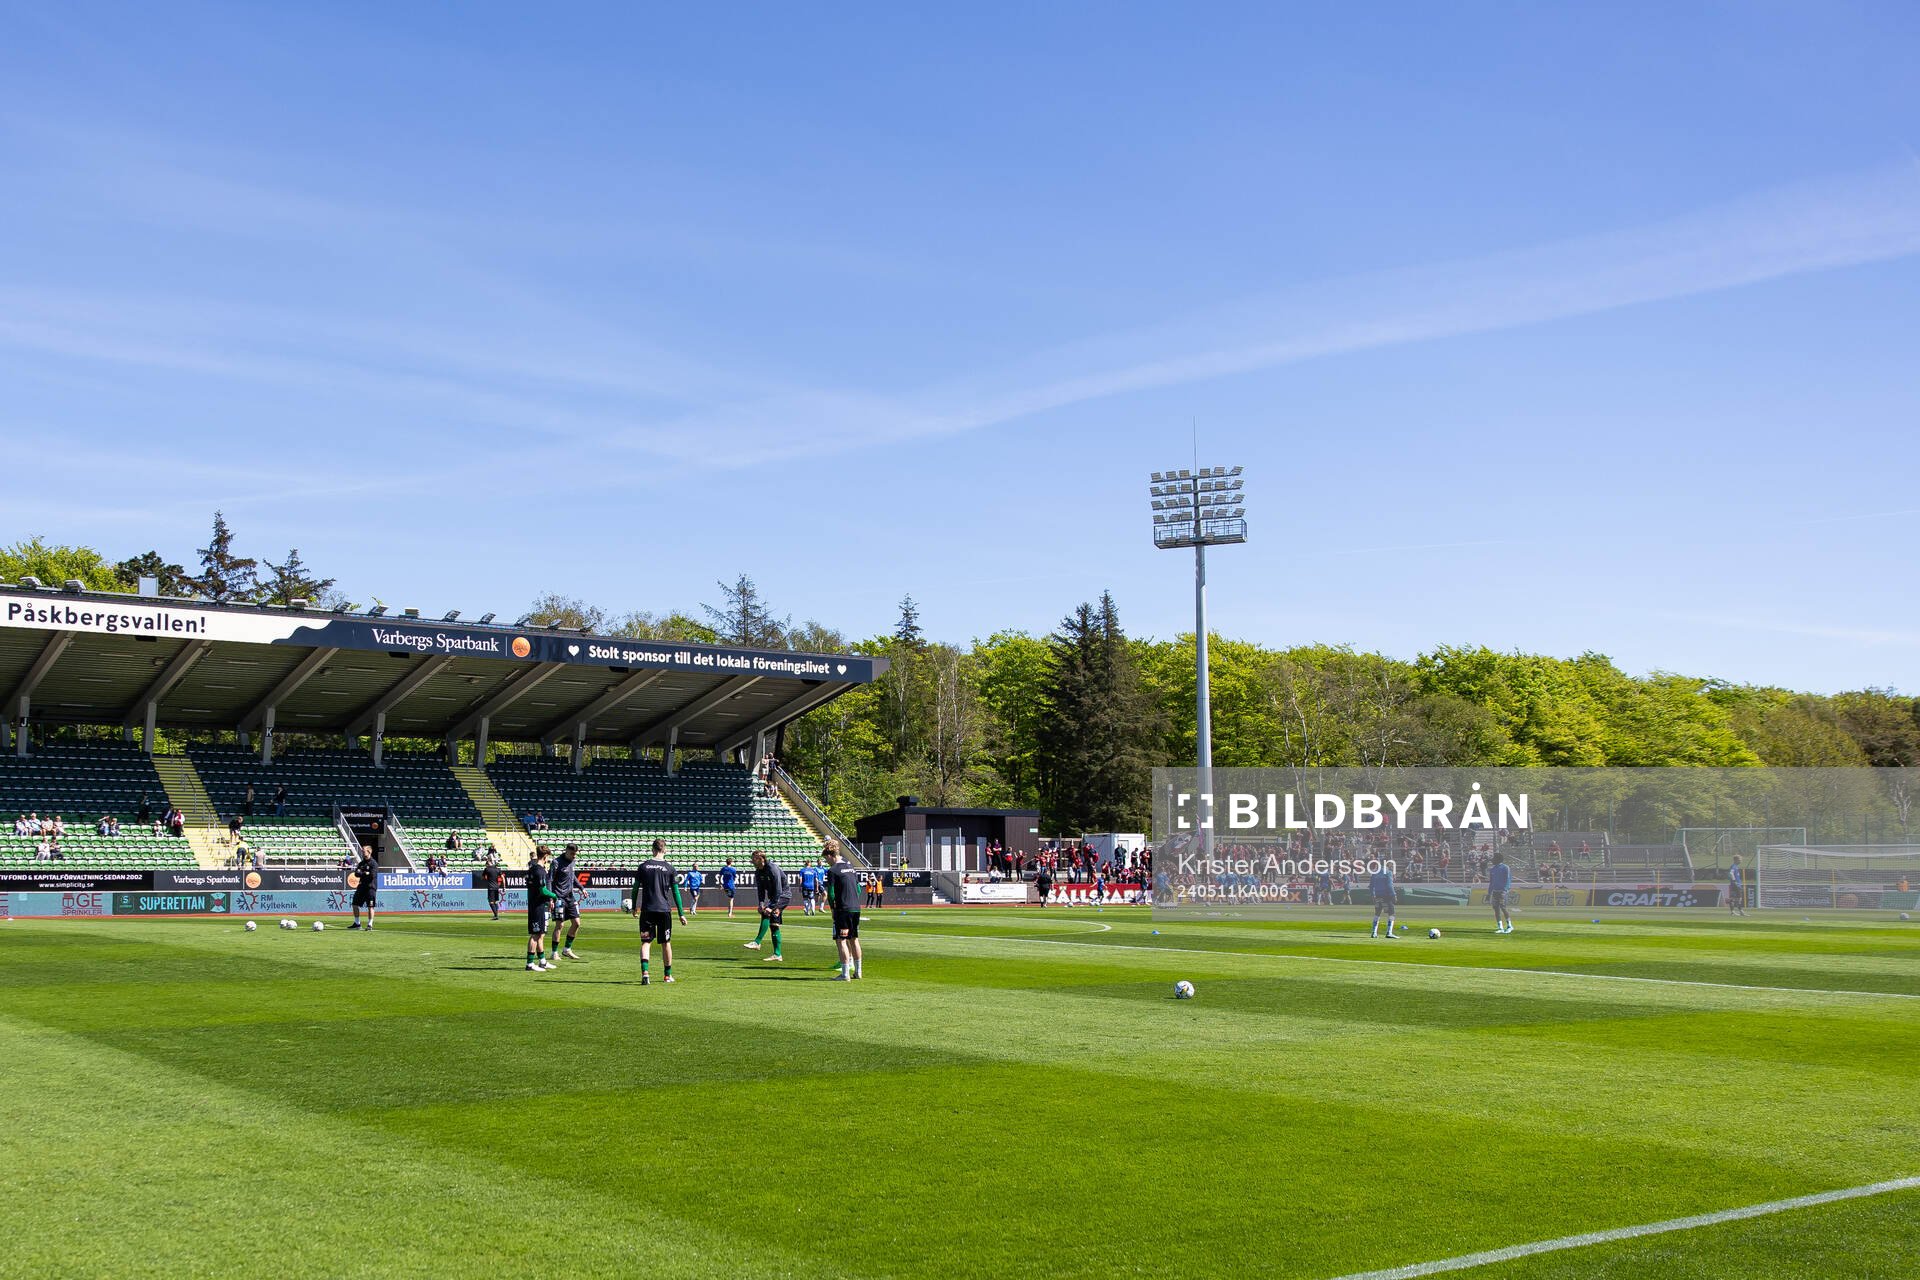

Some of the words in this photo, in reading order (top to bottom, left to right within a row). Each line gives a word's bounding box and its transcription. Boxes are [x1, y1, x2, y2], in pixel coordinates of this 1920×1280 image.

[8, 602, 206, 633] Påskbergsvallen!
[372, 628, 432, 651] Varbergs
[436, 633, 499, 653] Sparbank
[588, 645, 619, 660] Stolt
[622, 650, 671, 664] sponsor
[674, 651, 690, 664] till
[693, 653, 714, 666] det
[716, 654, 750, 669] lokala
[752, 657, 830, 675] föreningslivet
[173, 875, 205, 885] Varbergs
[206, 875, 240, 885] Sparbank
[279, 875, 309, 884] Varbergs
[310, 875, 342, 884] Sparbank
[383, 875, 425, 887] Hallands
[427, 875, 464, 890] Nyheter
[506, 877, 527, 886] VARBE
[591, 877, 618, 886] VARBERG
[260, 894, 274, 902] RM
[1608, 893, 1678, 906] CRAFT
[139, 896, 205, 911] SUPERETTAN
[260, 902, 298, 911] Kylteknik
[431, 900, 465, 909] Kylteknik
[586, 899, 617, 907] Kylteknik
